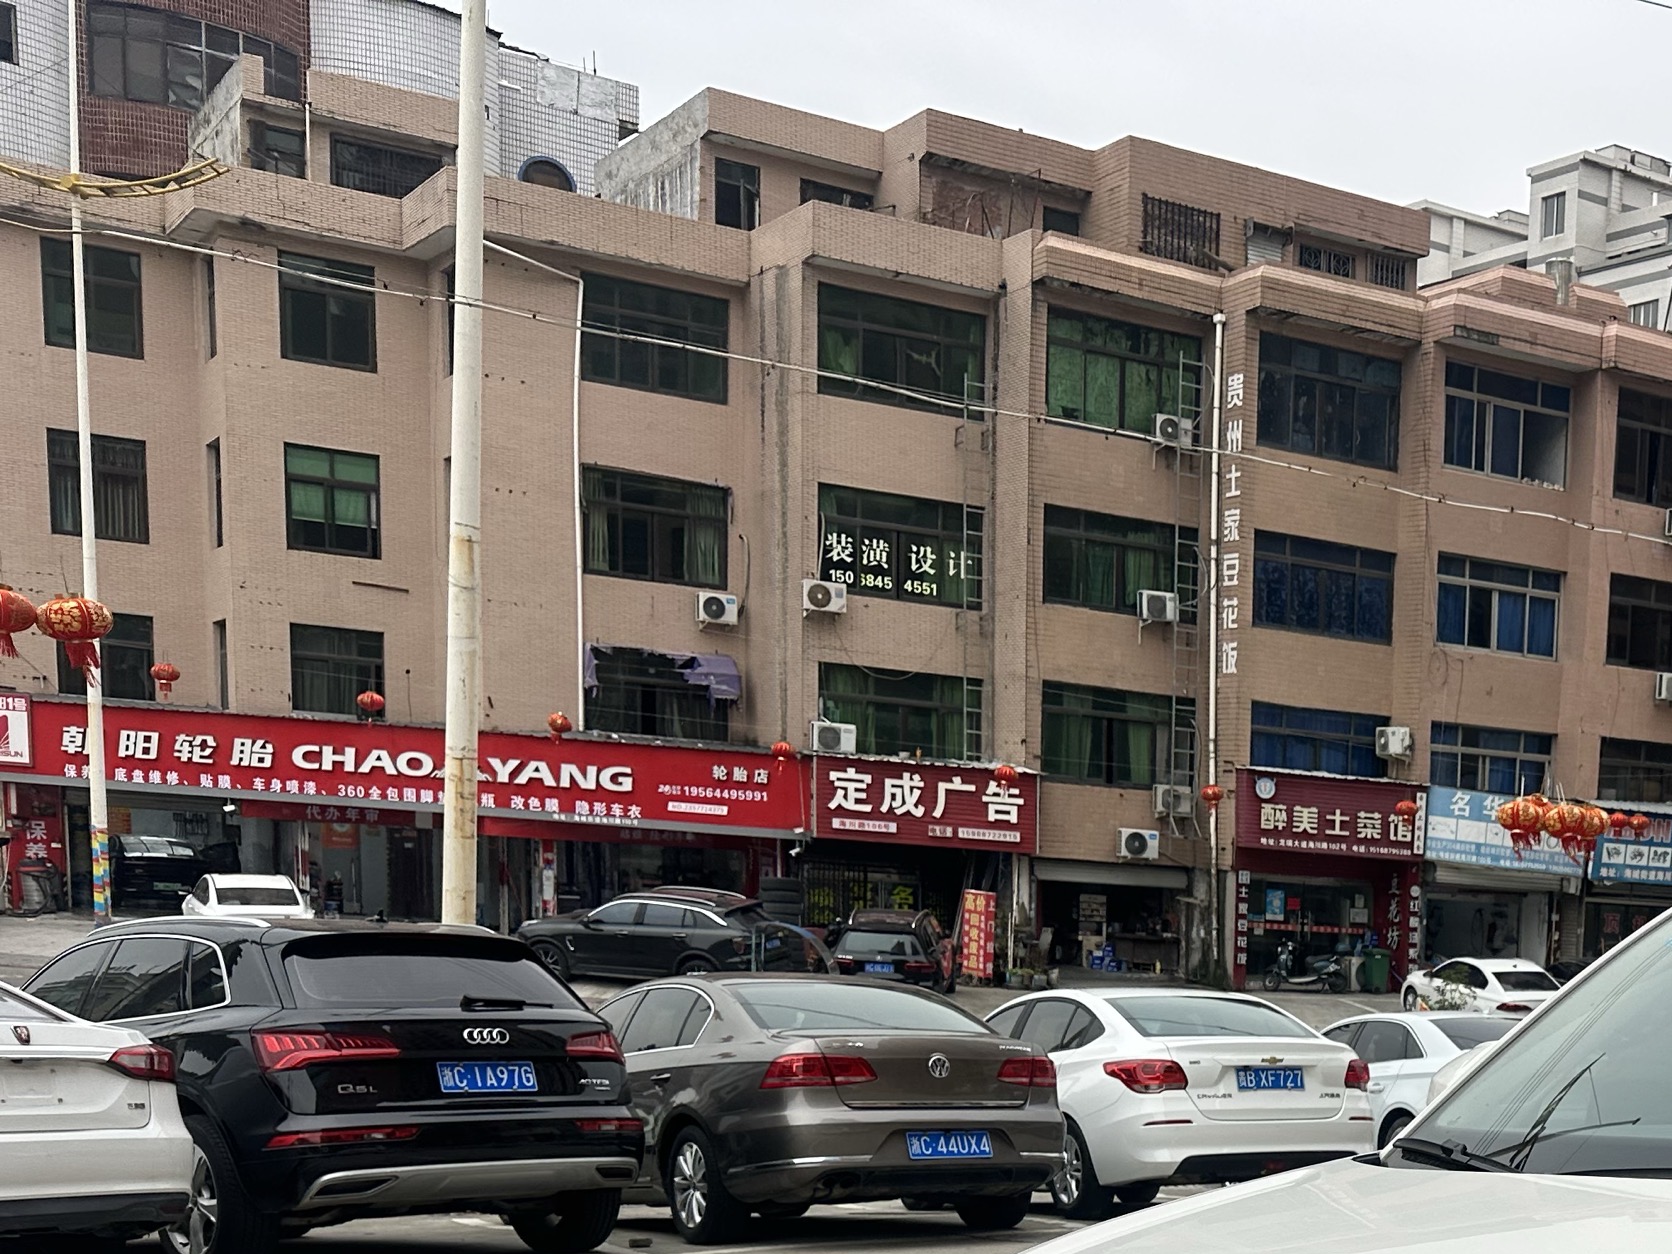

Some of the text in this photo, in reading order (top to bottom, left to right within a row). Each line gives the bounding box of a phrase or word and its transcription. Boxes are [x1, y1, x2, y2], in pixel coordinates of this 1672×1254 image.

[1222, 373, 1244, 675] 贵州土家豆花饭
[825, 532, 973, 580] 装潢设计
[829, 569, 854, 584] 150
[903, 579, 937, 596] 4551
[712, 764, 770, 785] 轮胎店
[306, 805, 380, 823] 代办年审
[828, 767, 1025, 824] 定成广告
[25, 819, 48, 859] 保养
[1260, 803, 1412, 842] 醉美土菜馆
[337, 1084, 378, 1094] Q5L
